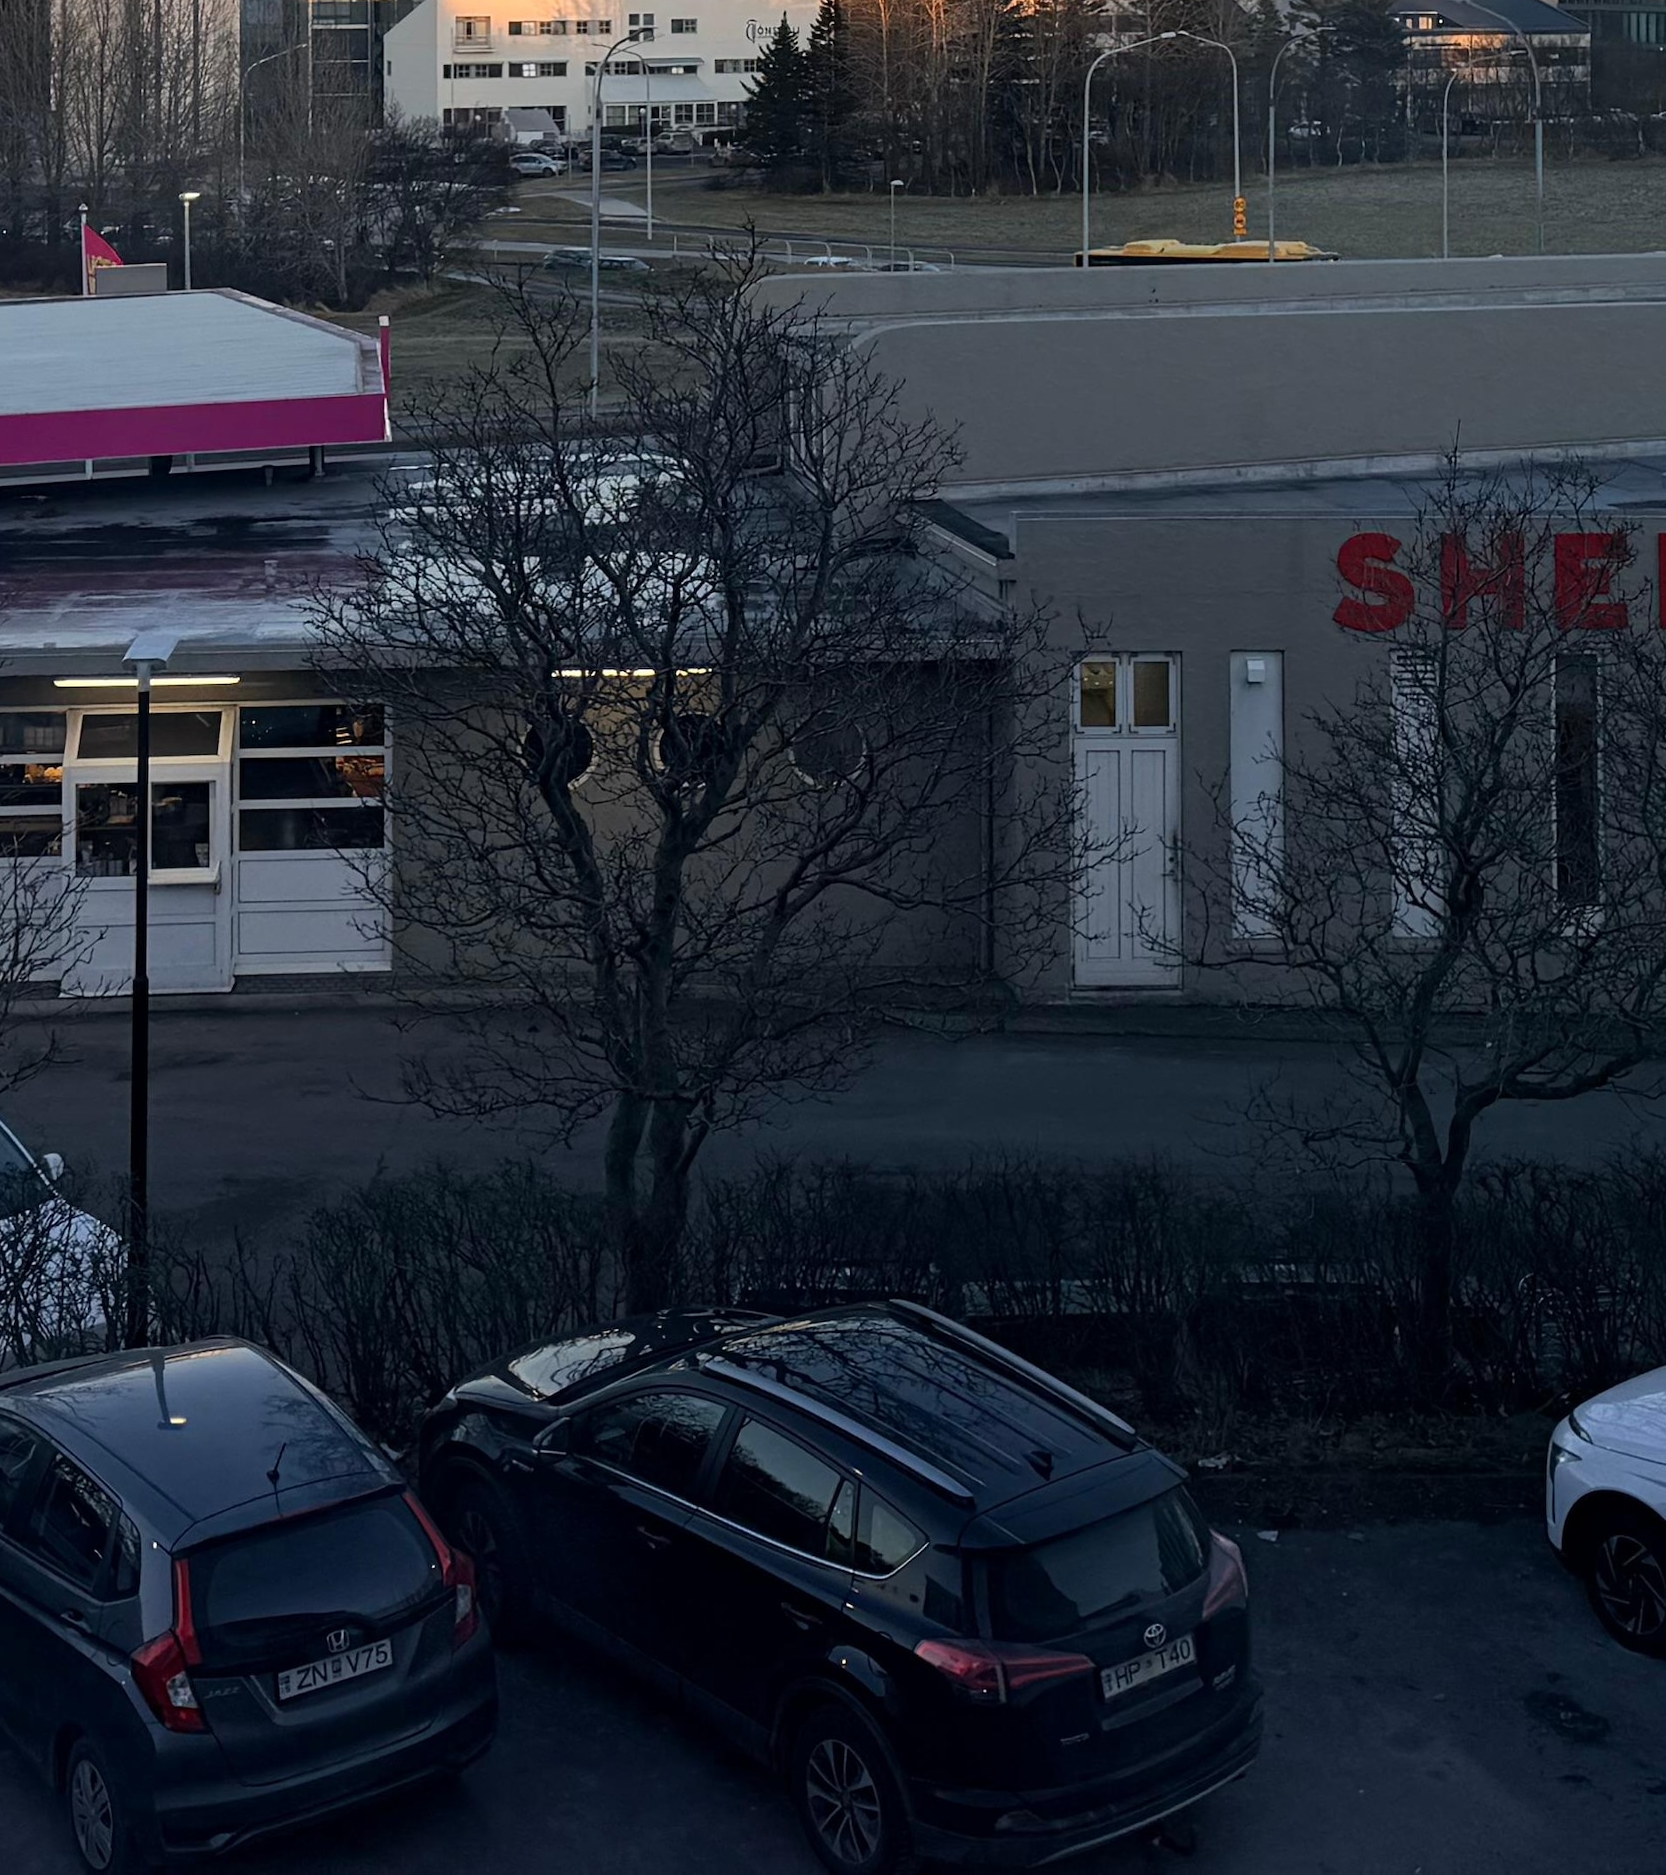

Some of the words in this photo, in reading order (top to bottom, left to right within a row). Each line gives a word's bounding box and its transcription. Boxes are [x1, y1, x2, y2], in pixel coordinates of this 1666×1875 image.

[296, 1663, 328, 1691] ZN
[346, 1643, 388, 1673] V75
[1114, 1662, 1141, 1689] HP
[1155, 1639, 1191, 1669] T40
